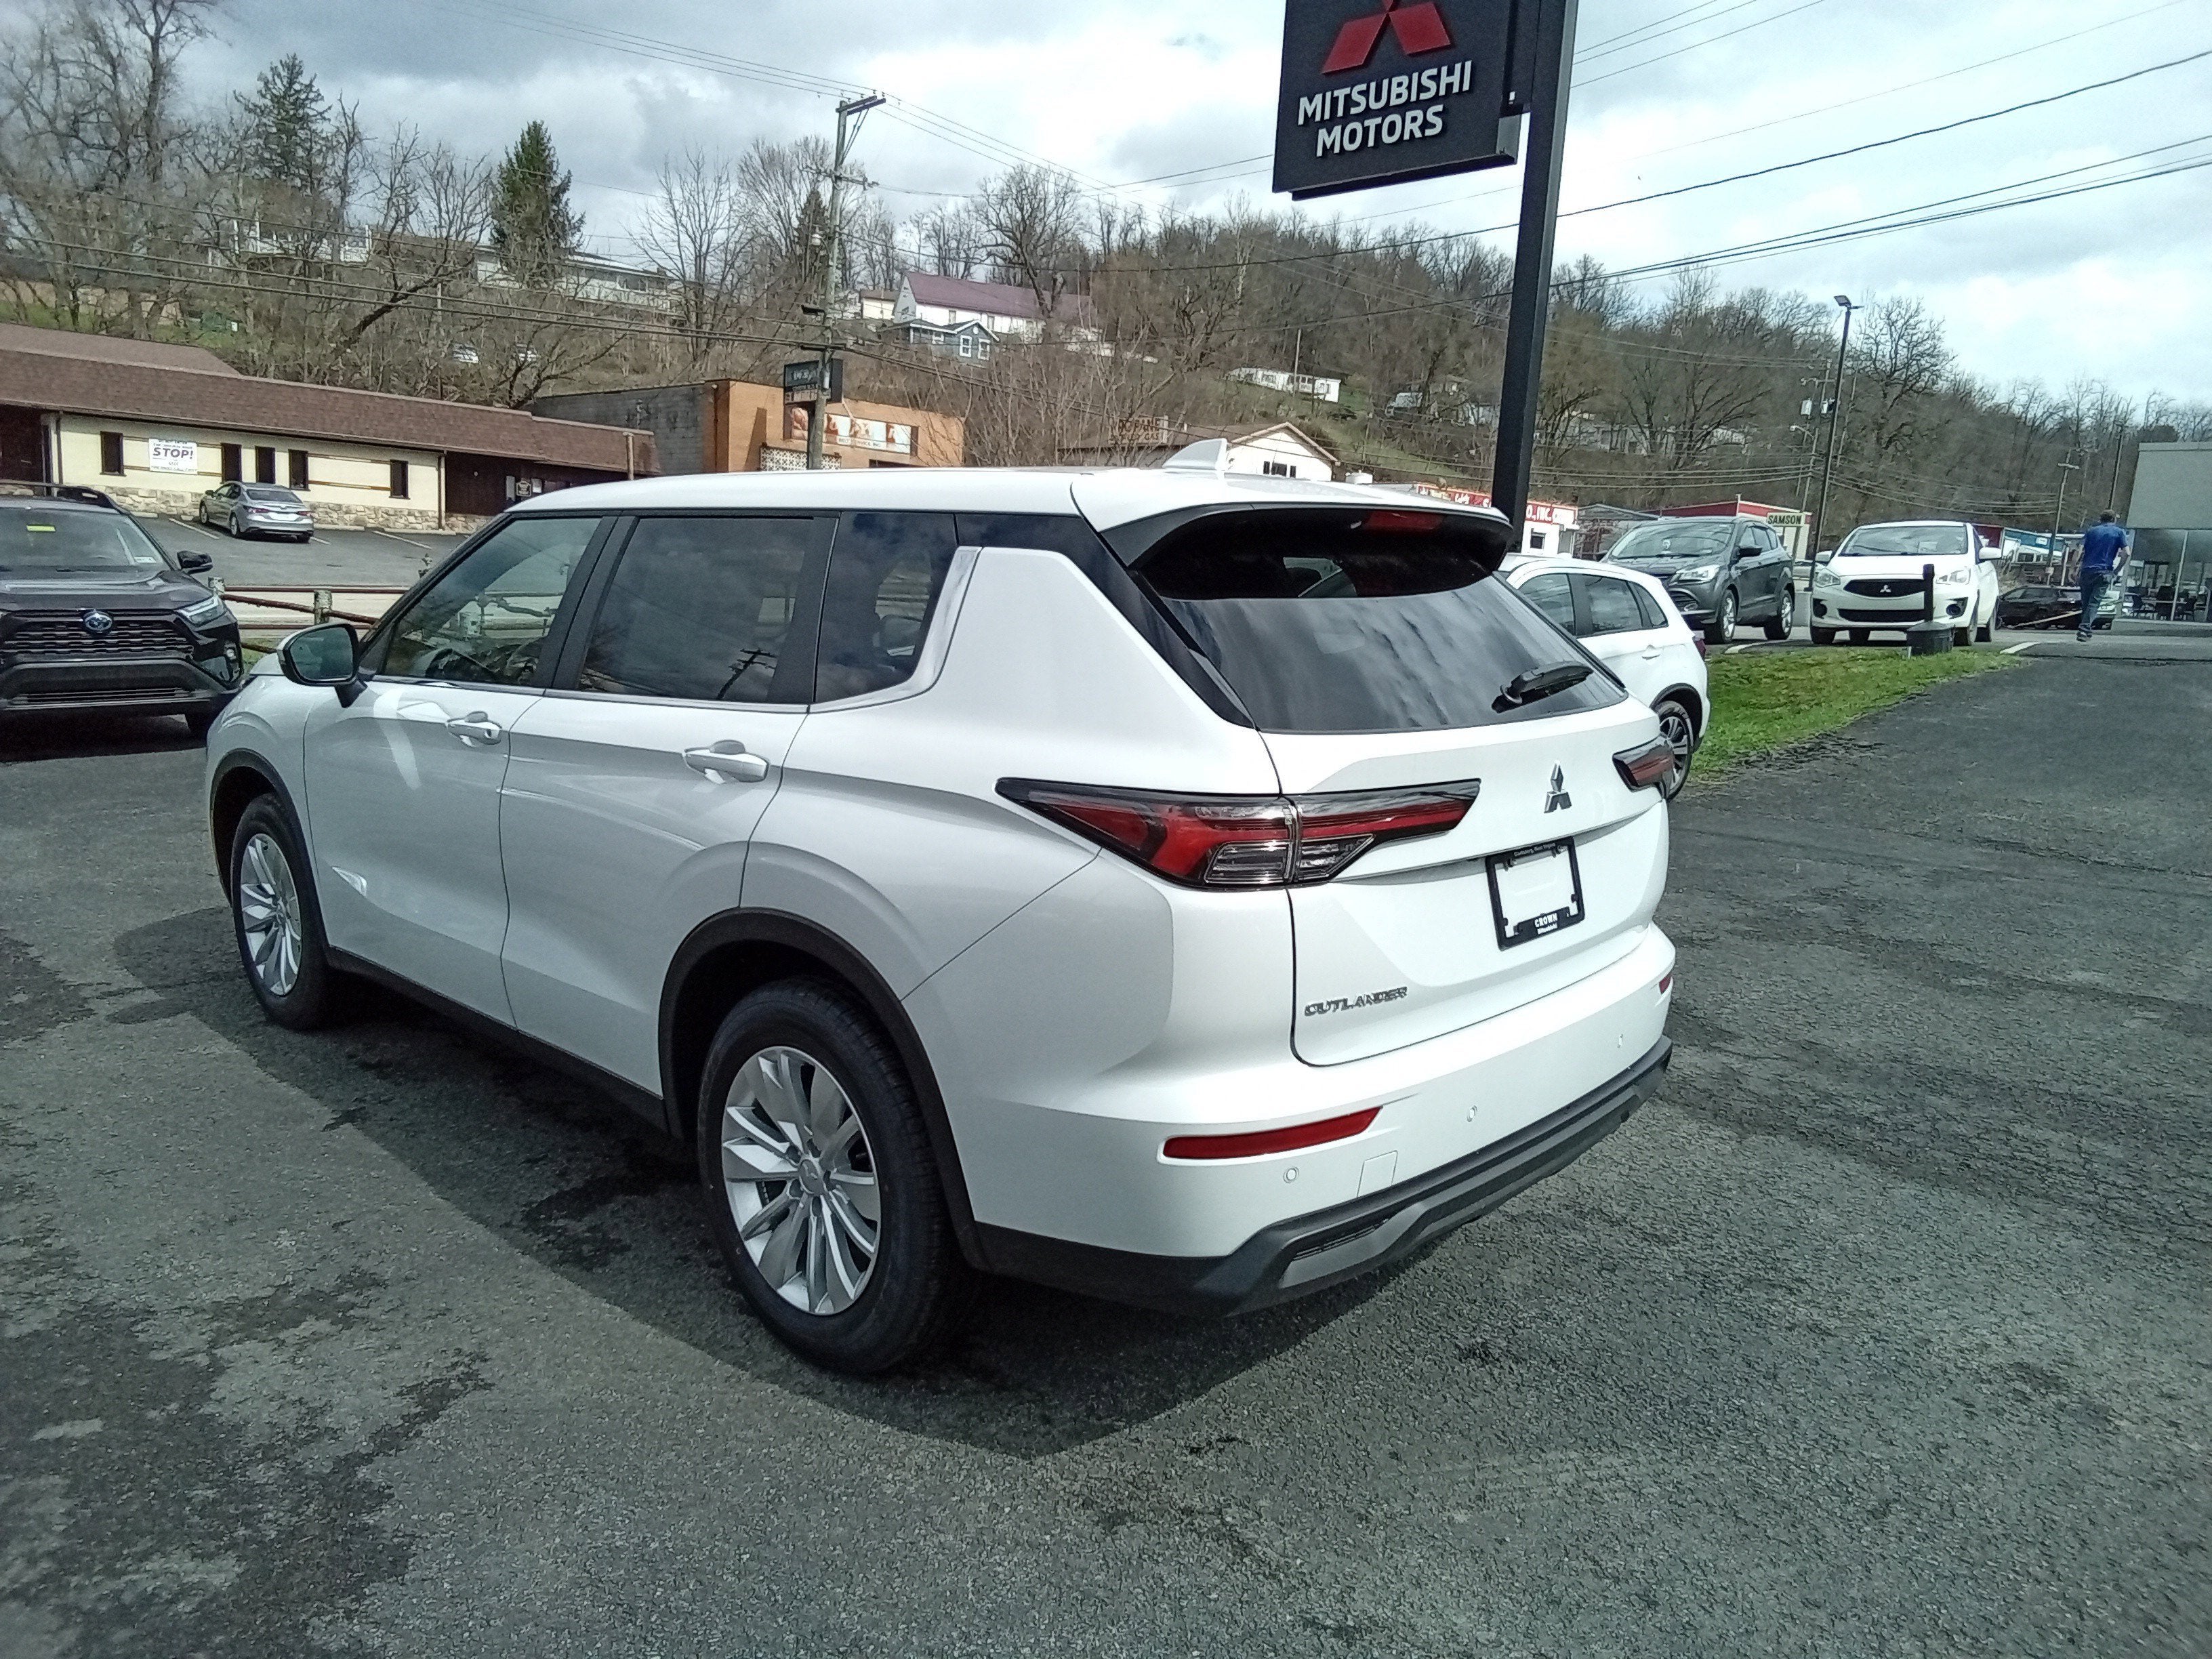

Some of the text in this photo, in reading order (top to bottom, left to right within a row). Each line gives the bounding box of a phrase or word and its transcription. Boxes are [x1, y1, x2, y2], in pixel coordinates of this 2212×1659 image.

[1298, 60, 1473, 125] MITSUBISHI
[1316, 104, 1444, 157] MOTORS
[153, 447, 194, 459] STOP!
[1767, 514, 1802, 525] SAMSON
[1534, 912, 1558, 928] CROWN
[1305, 986, 1408, 1017] OUTLANDER
